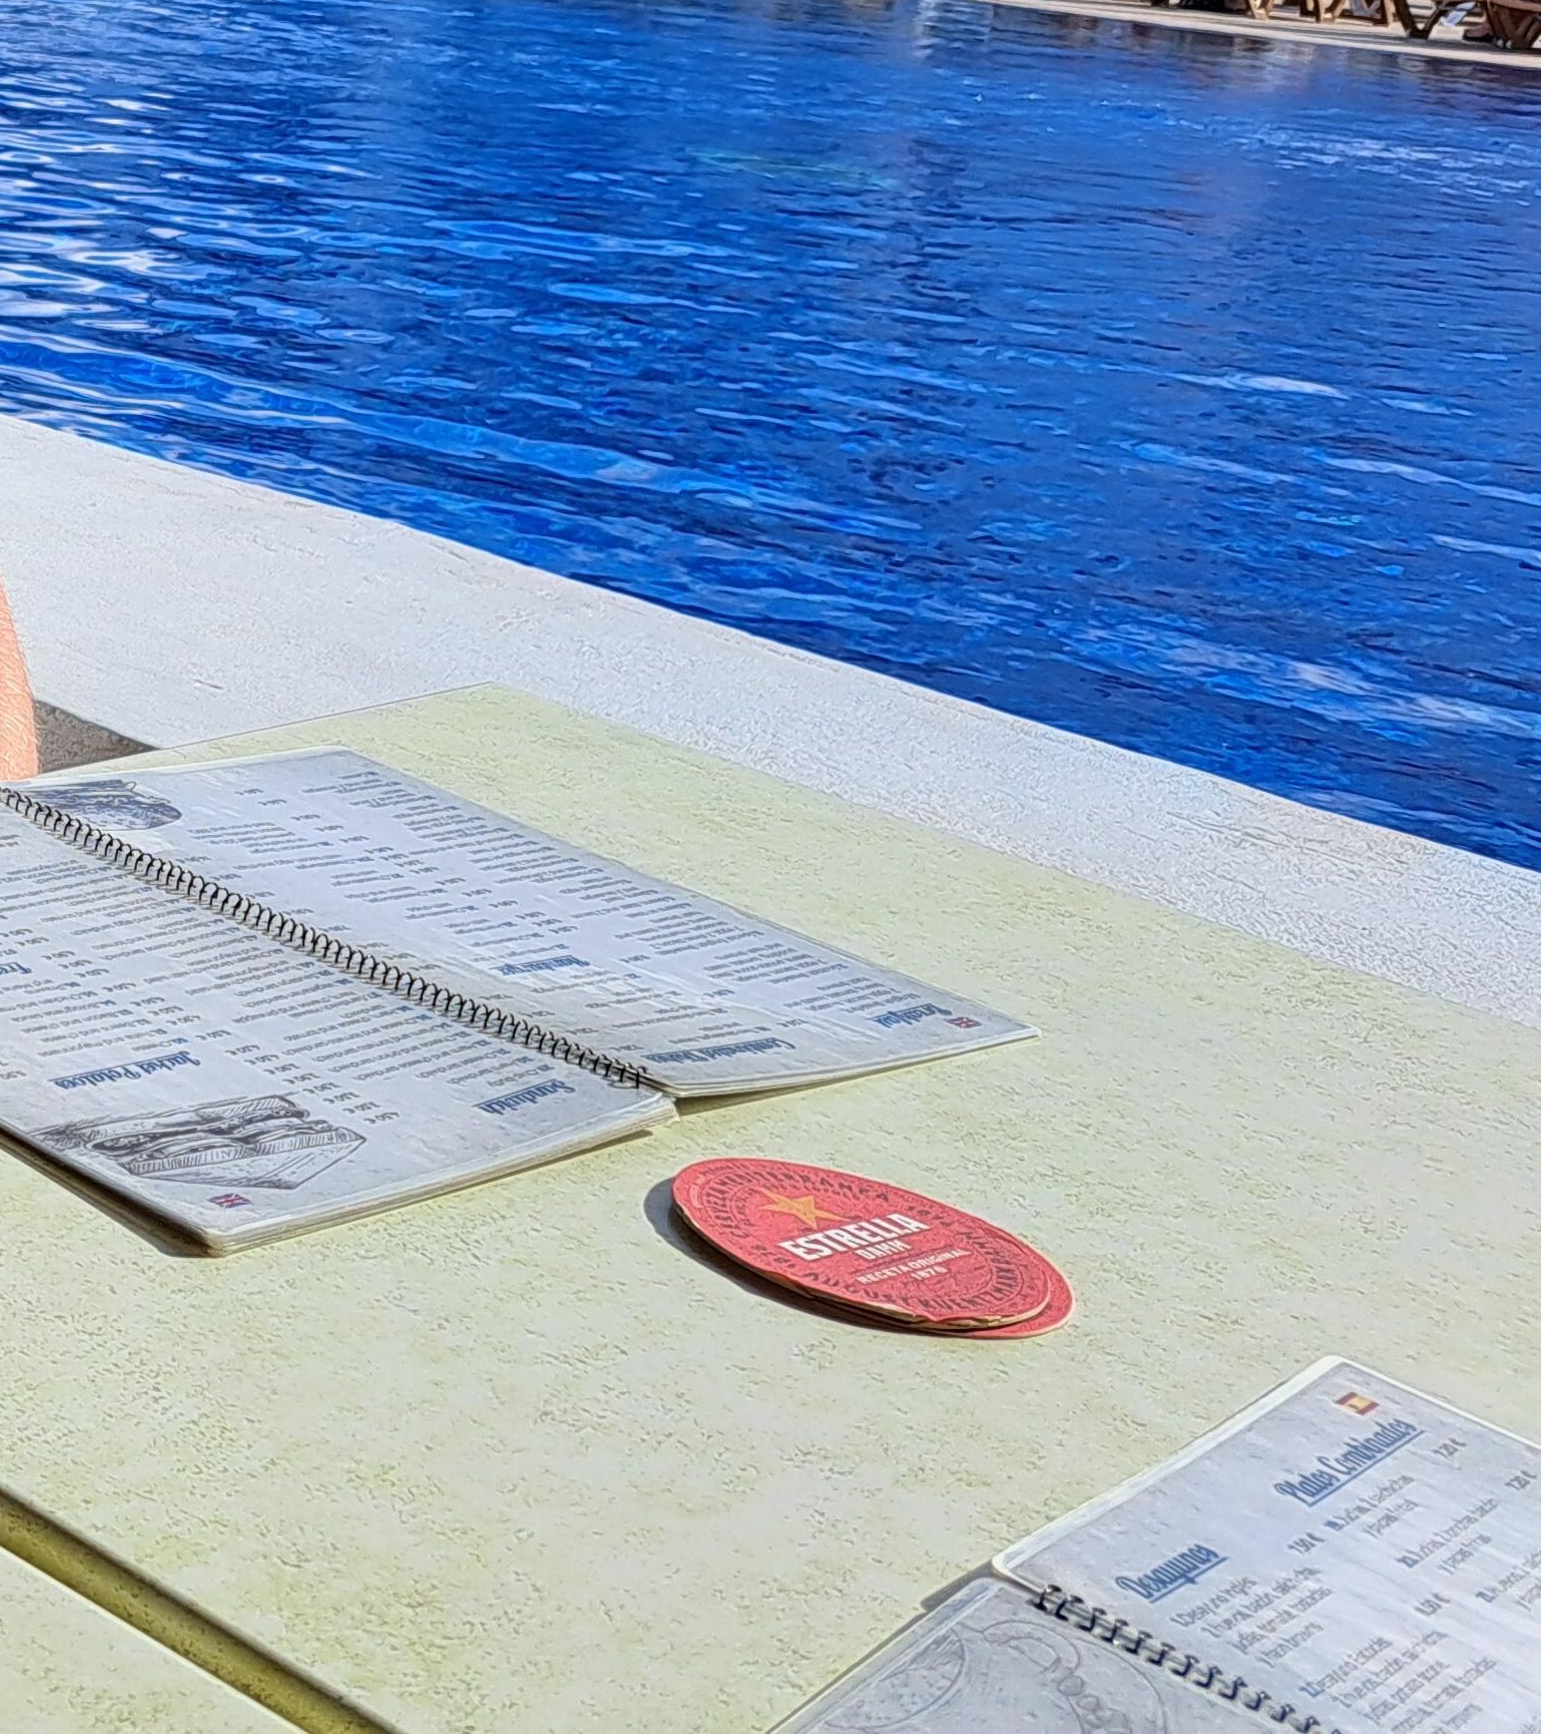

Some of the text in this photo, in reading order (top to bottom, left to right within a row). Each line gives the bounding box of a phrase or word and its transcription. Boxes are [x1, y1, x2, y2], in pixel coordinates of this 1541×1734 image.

[52, 1050, 201, 1090] Jacket Potatoes
[472, 1079, 576, 1116] Sandwich
[777, 1212, 931, 1262] ESTRELLA
[852, 1239, 913, 1262] DAMM
[855, 1264, 908, 1285] RECETA
[1272, 1468, 1340, 1504] Platos
[1314, 1417, 1417, 1475] Combinados
[1113, 1542, 1220, 1600] Desayunos
